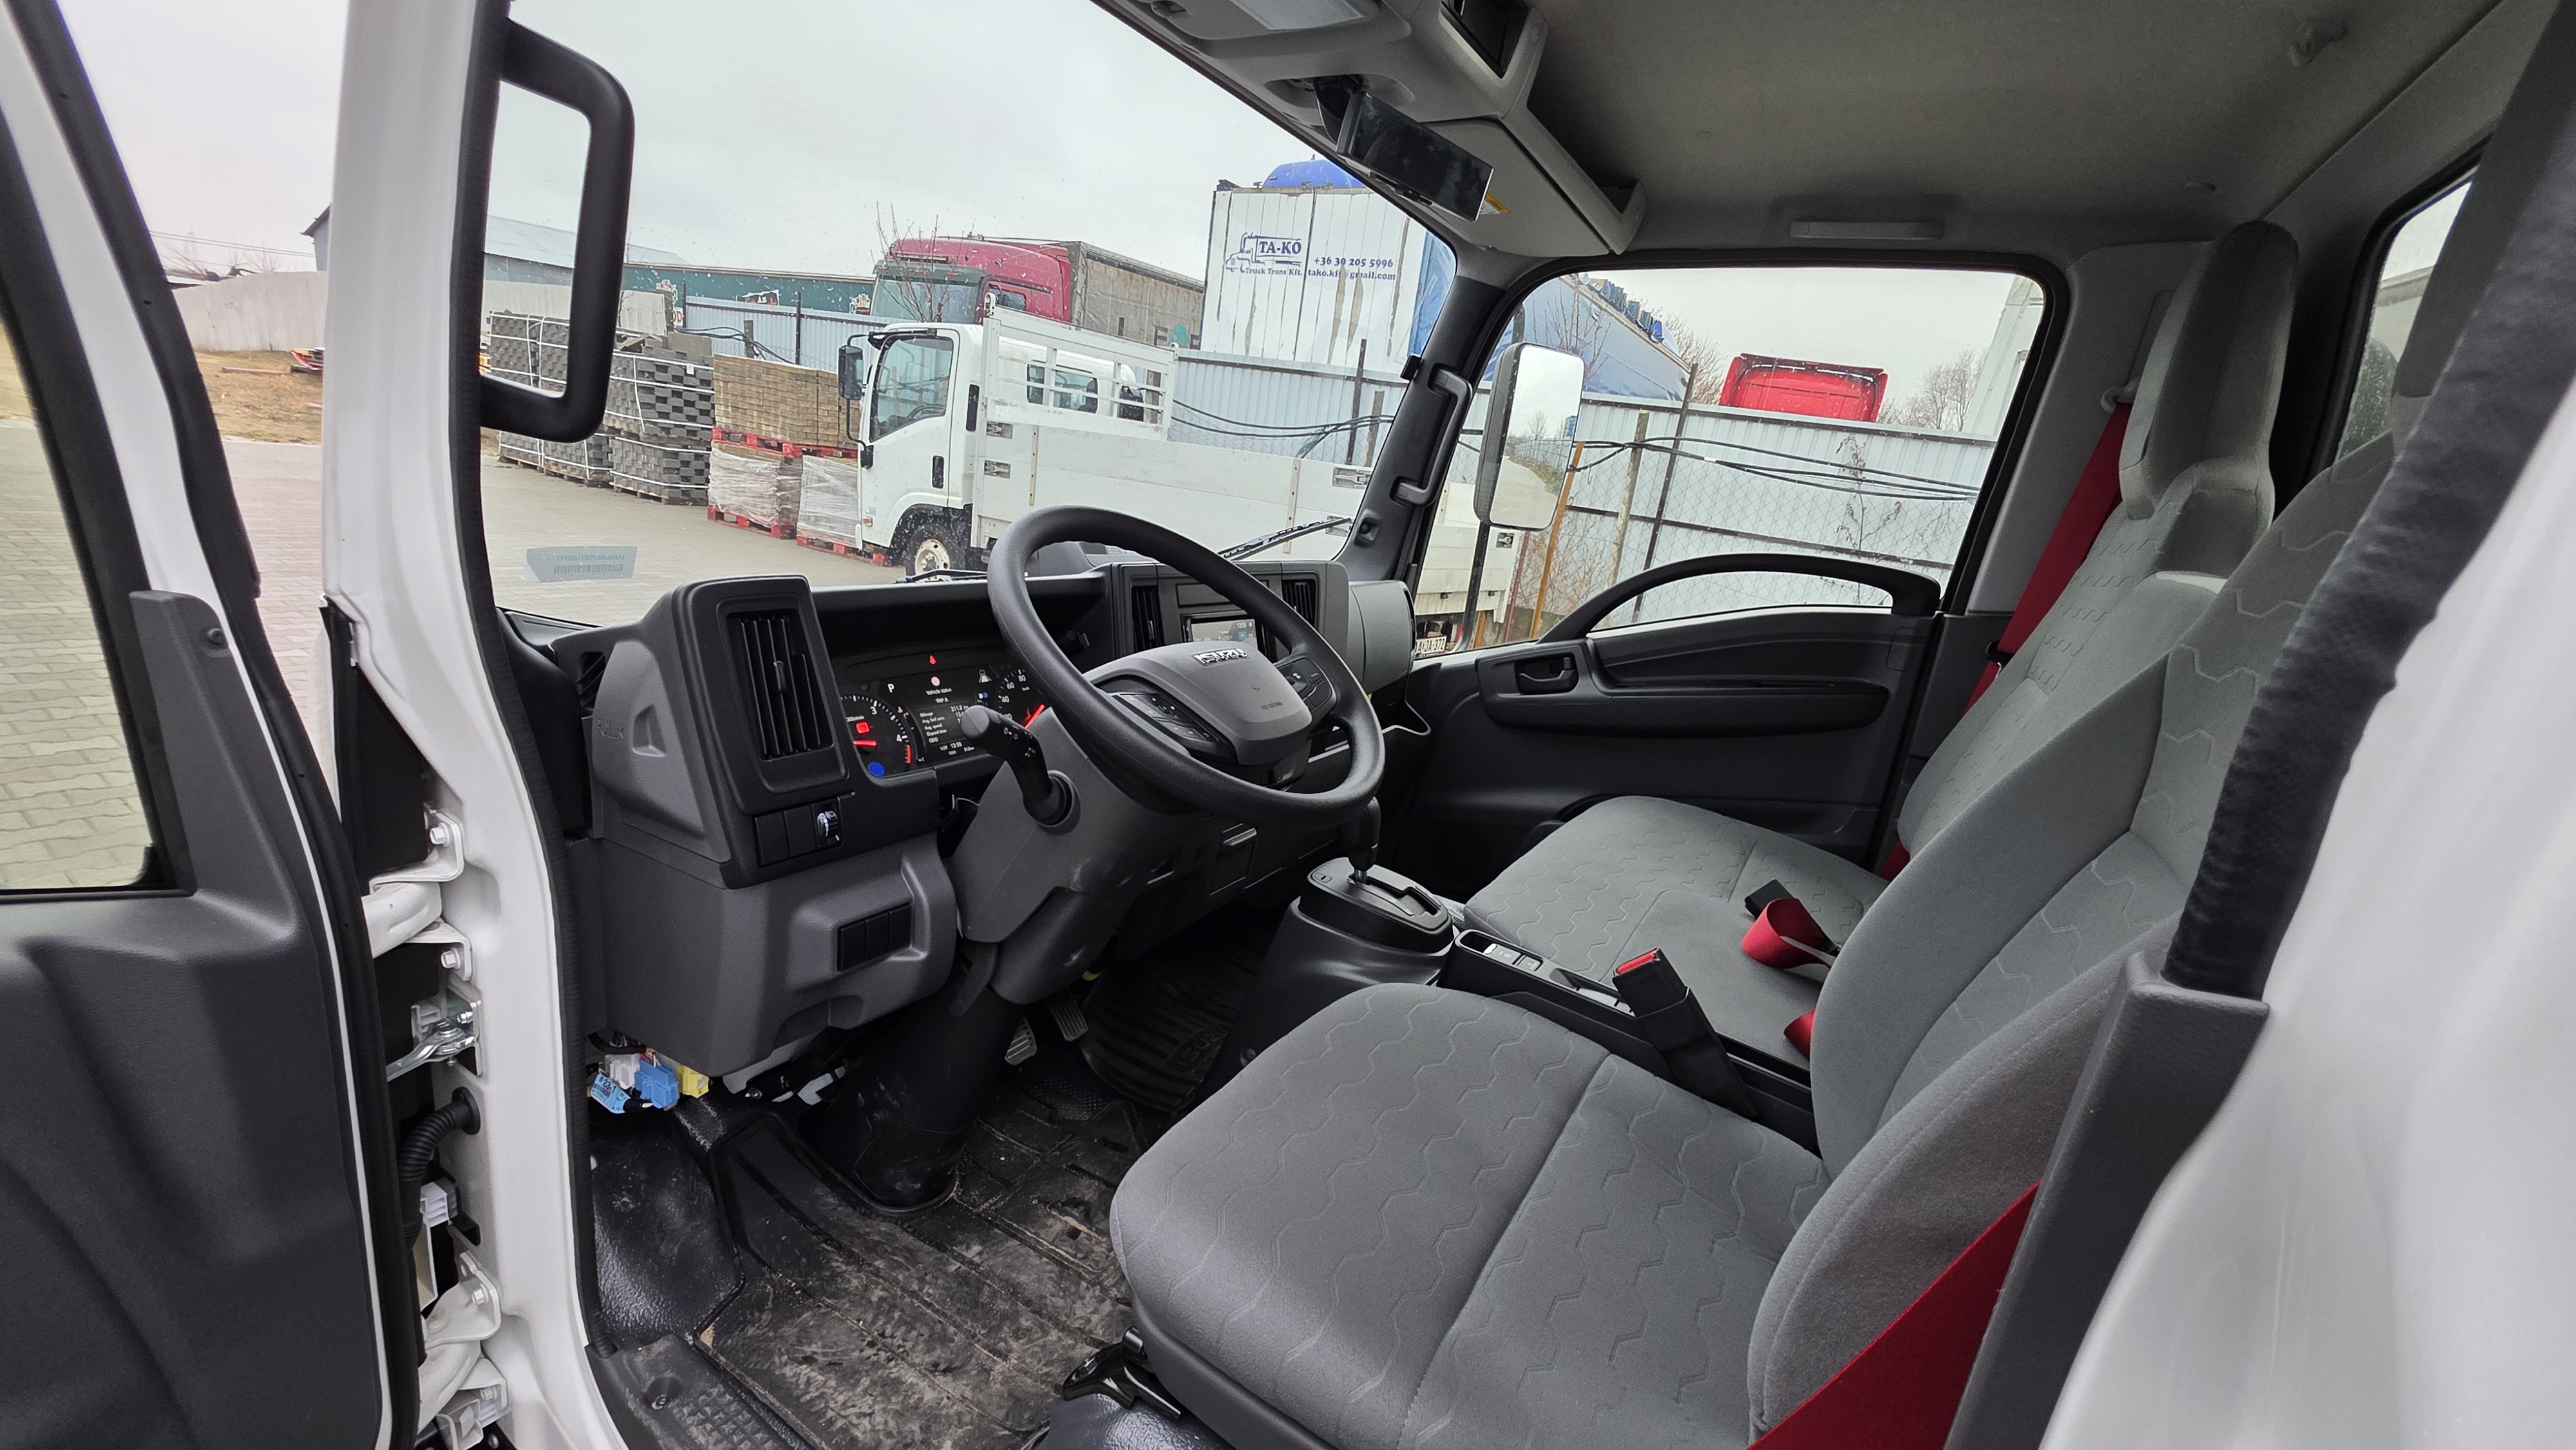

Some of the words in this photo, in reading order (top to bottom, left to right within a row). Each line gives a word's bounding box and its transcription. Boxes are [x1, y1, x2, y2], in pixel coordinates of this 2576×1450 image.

[1314, 257, 1332, 266] +36
[1334, 258, 1346, 266] 30
[1349, 258, 1367, 267] 205
[1368, 259, 1394, 268] 5996
[1193, 648, 1248, 664] ISUZU
[870, 706, 877, 715] 3
